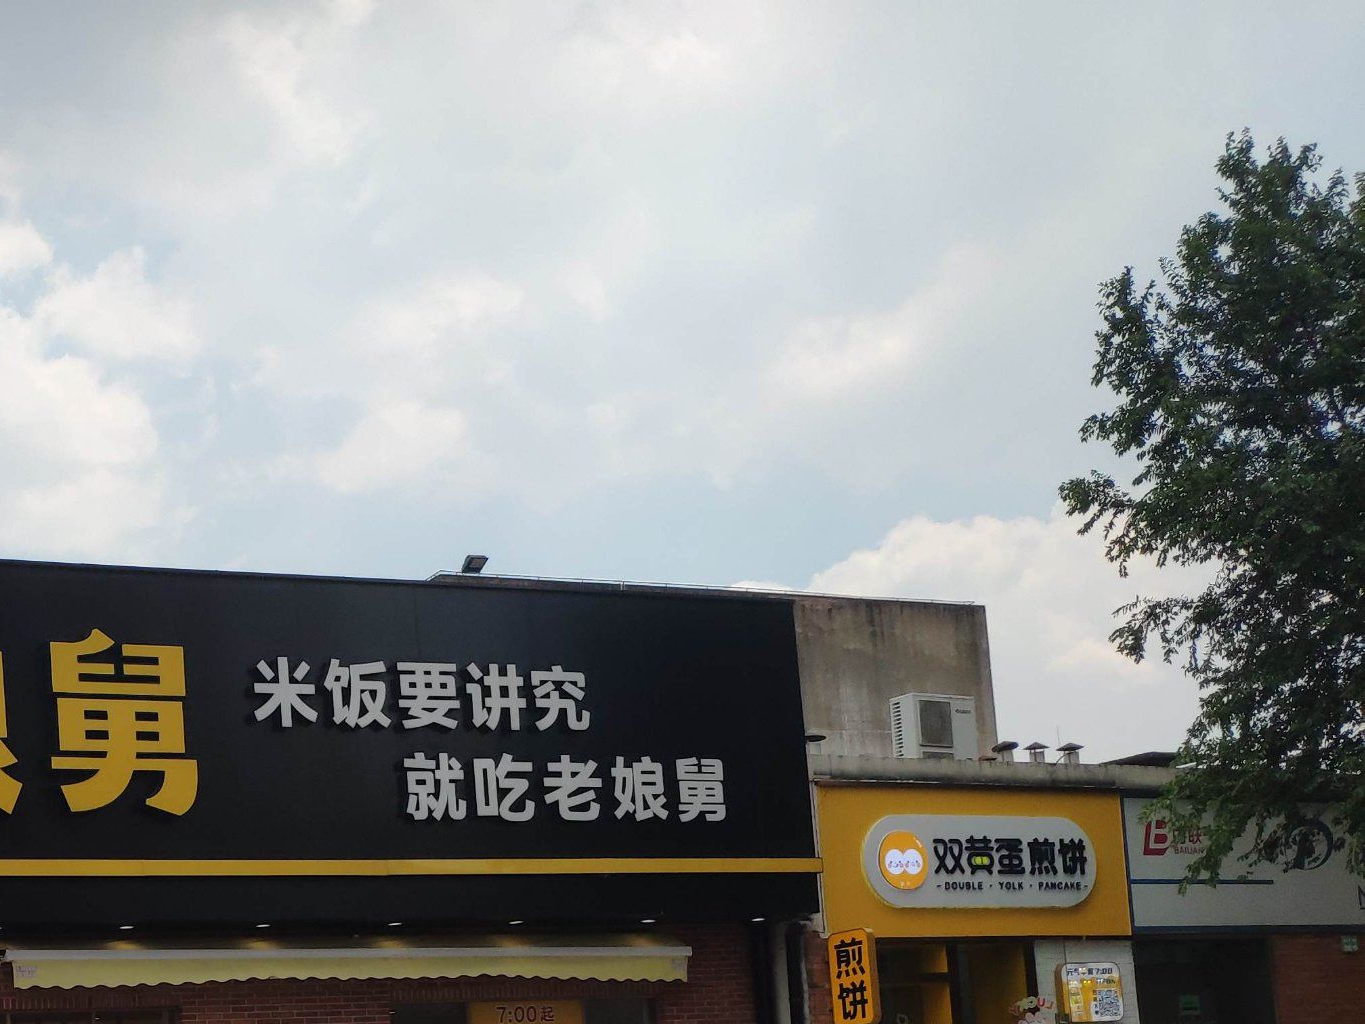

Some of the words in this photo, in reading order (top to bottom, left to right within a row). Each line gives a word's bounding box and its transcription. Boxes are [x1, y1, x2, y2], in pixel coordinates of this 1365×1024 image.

[253, 656, 591, 731] 米饭要讲究
[403, 752, 727, 822] 就吃老娘舅
[933, 835, 1087, 875] 双黄蛋煎饼
[944, 881, 983, 890] DOUBLE
[998, 881, 1024, 890] YOLK
[1038, 881, 1082, 890] PANCAKE
[834, 937, 868, 1020] 煎饼
